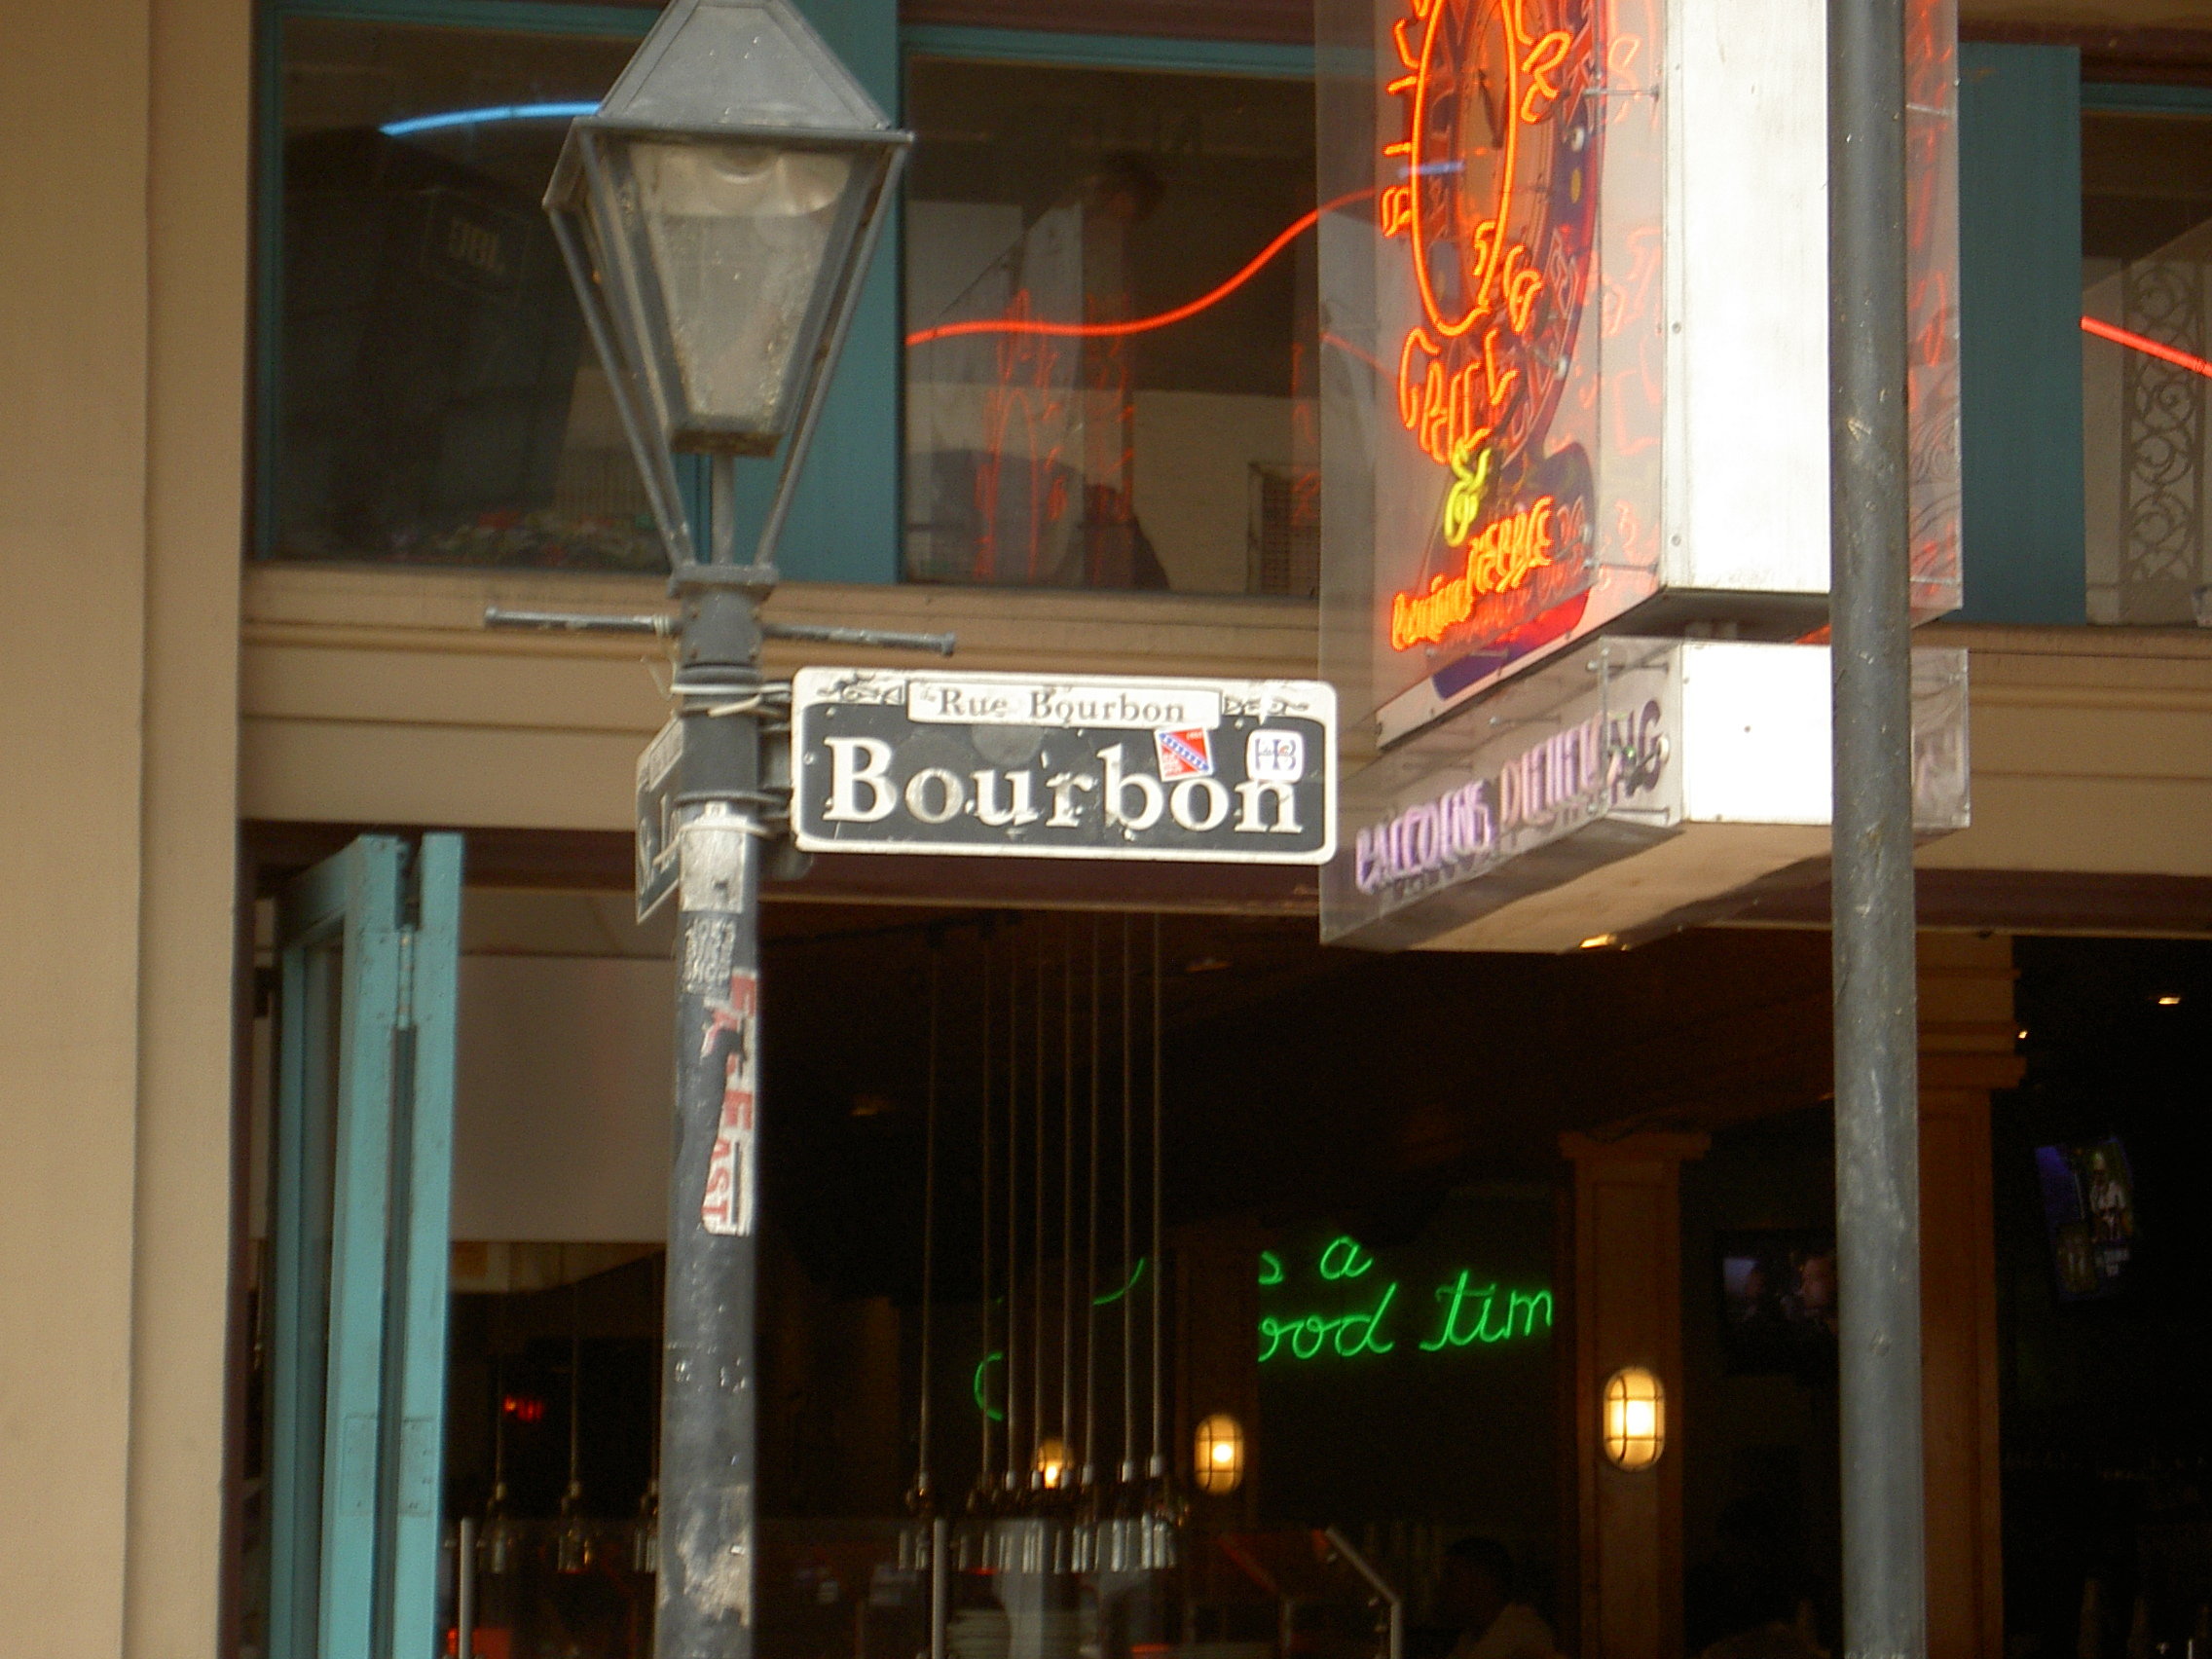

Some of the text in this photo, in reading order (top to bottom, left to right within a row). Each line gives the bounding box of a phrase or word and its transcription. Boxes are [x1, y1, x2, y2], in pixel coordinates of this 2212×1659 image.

[938, 687, 1185, 723] Rue Bourbon
[822, 736, 1304, 834] Bourbon
[1319, 1235, 1373, 1281] a
[1419, 1269, 1553, 1352] tim
